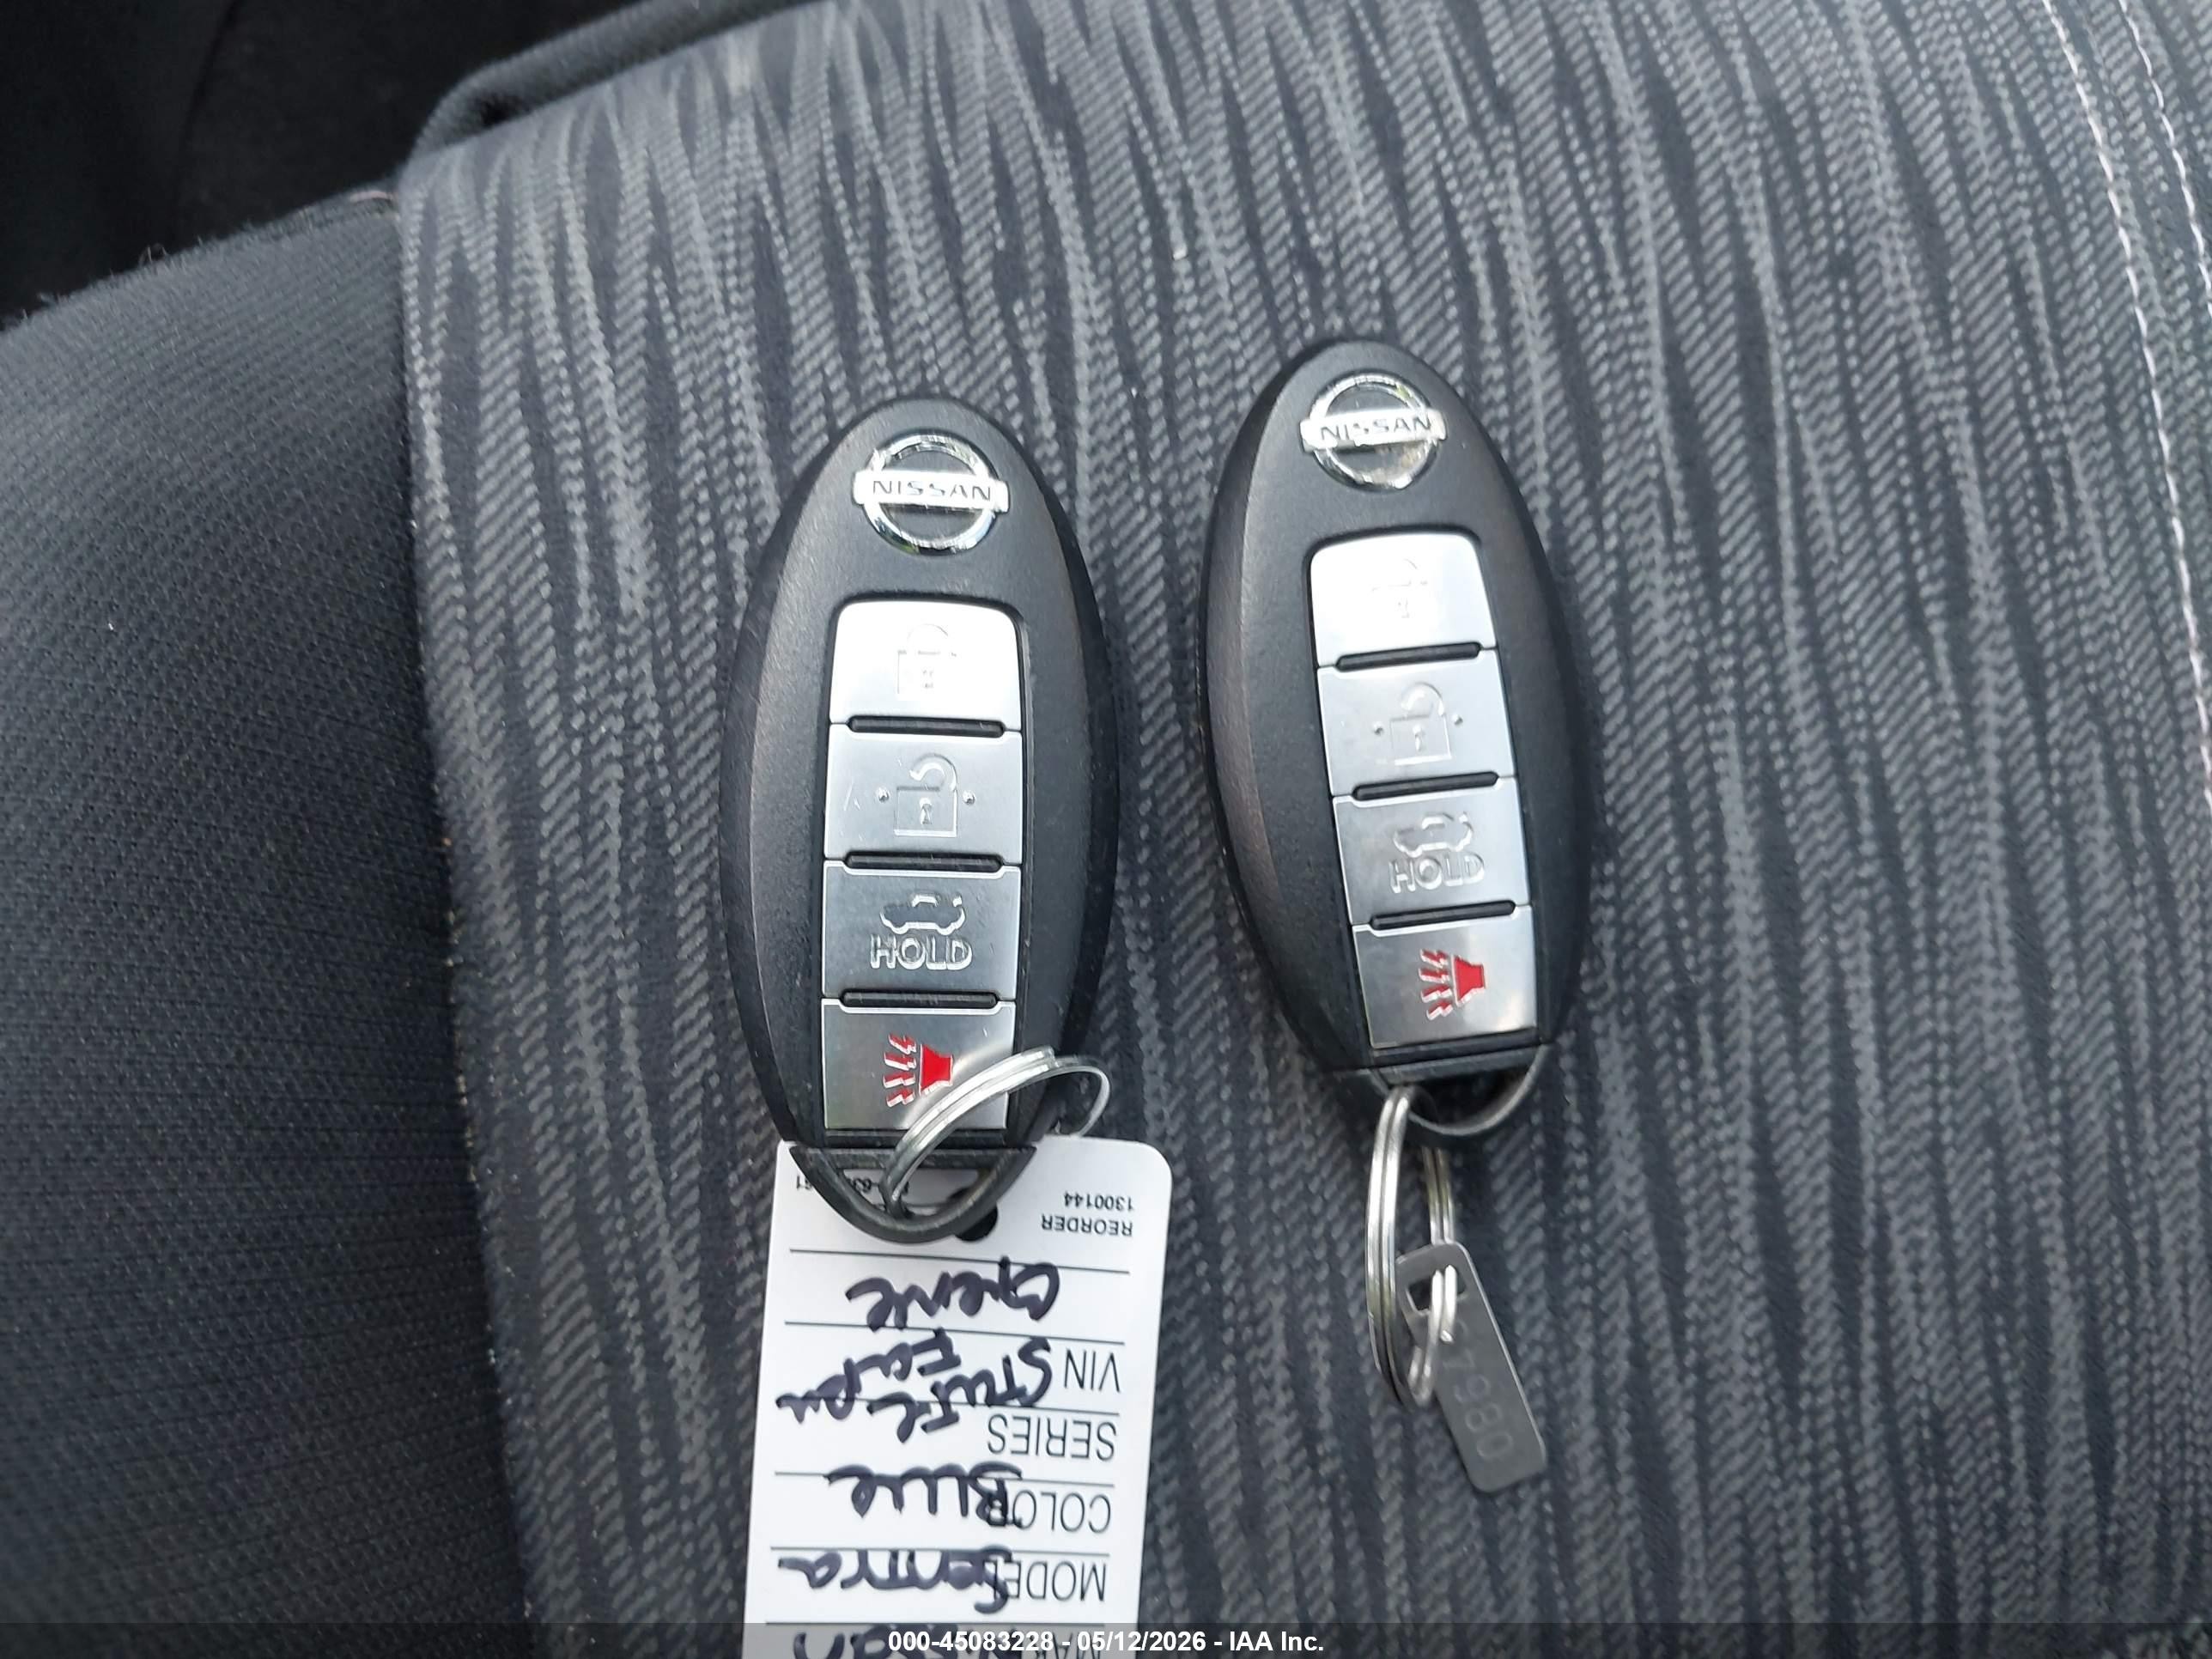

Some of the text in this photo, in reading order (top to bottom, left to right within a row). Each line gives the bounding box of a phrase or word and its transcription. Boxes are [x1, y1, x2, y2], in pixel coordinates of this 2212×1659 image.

[1320, 416, 1431, 441] NISSAN
[872, 479, 991, 501] NISSAN
[1389, 857, 1485, 894] HOLD
[870, 933, 974, 971] HOLD
[1063, 1191, 1133, 1212] 1300144
[1041, 1213, 1133, 1237] REORDER
[1062, 1350, 1121, 1393] VIN
[988, 1413, 1116, 1461] SERIES
